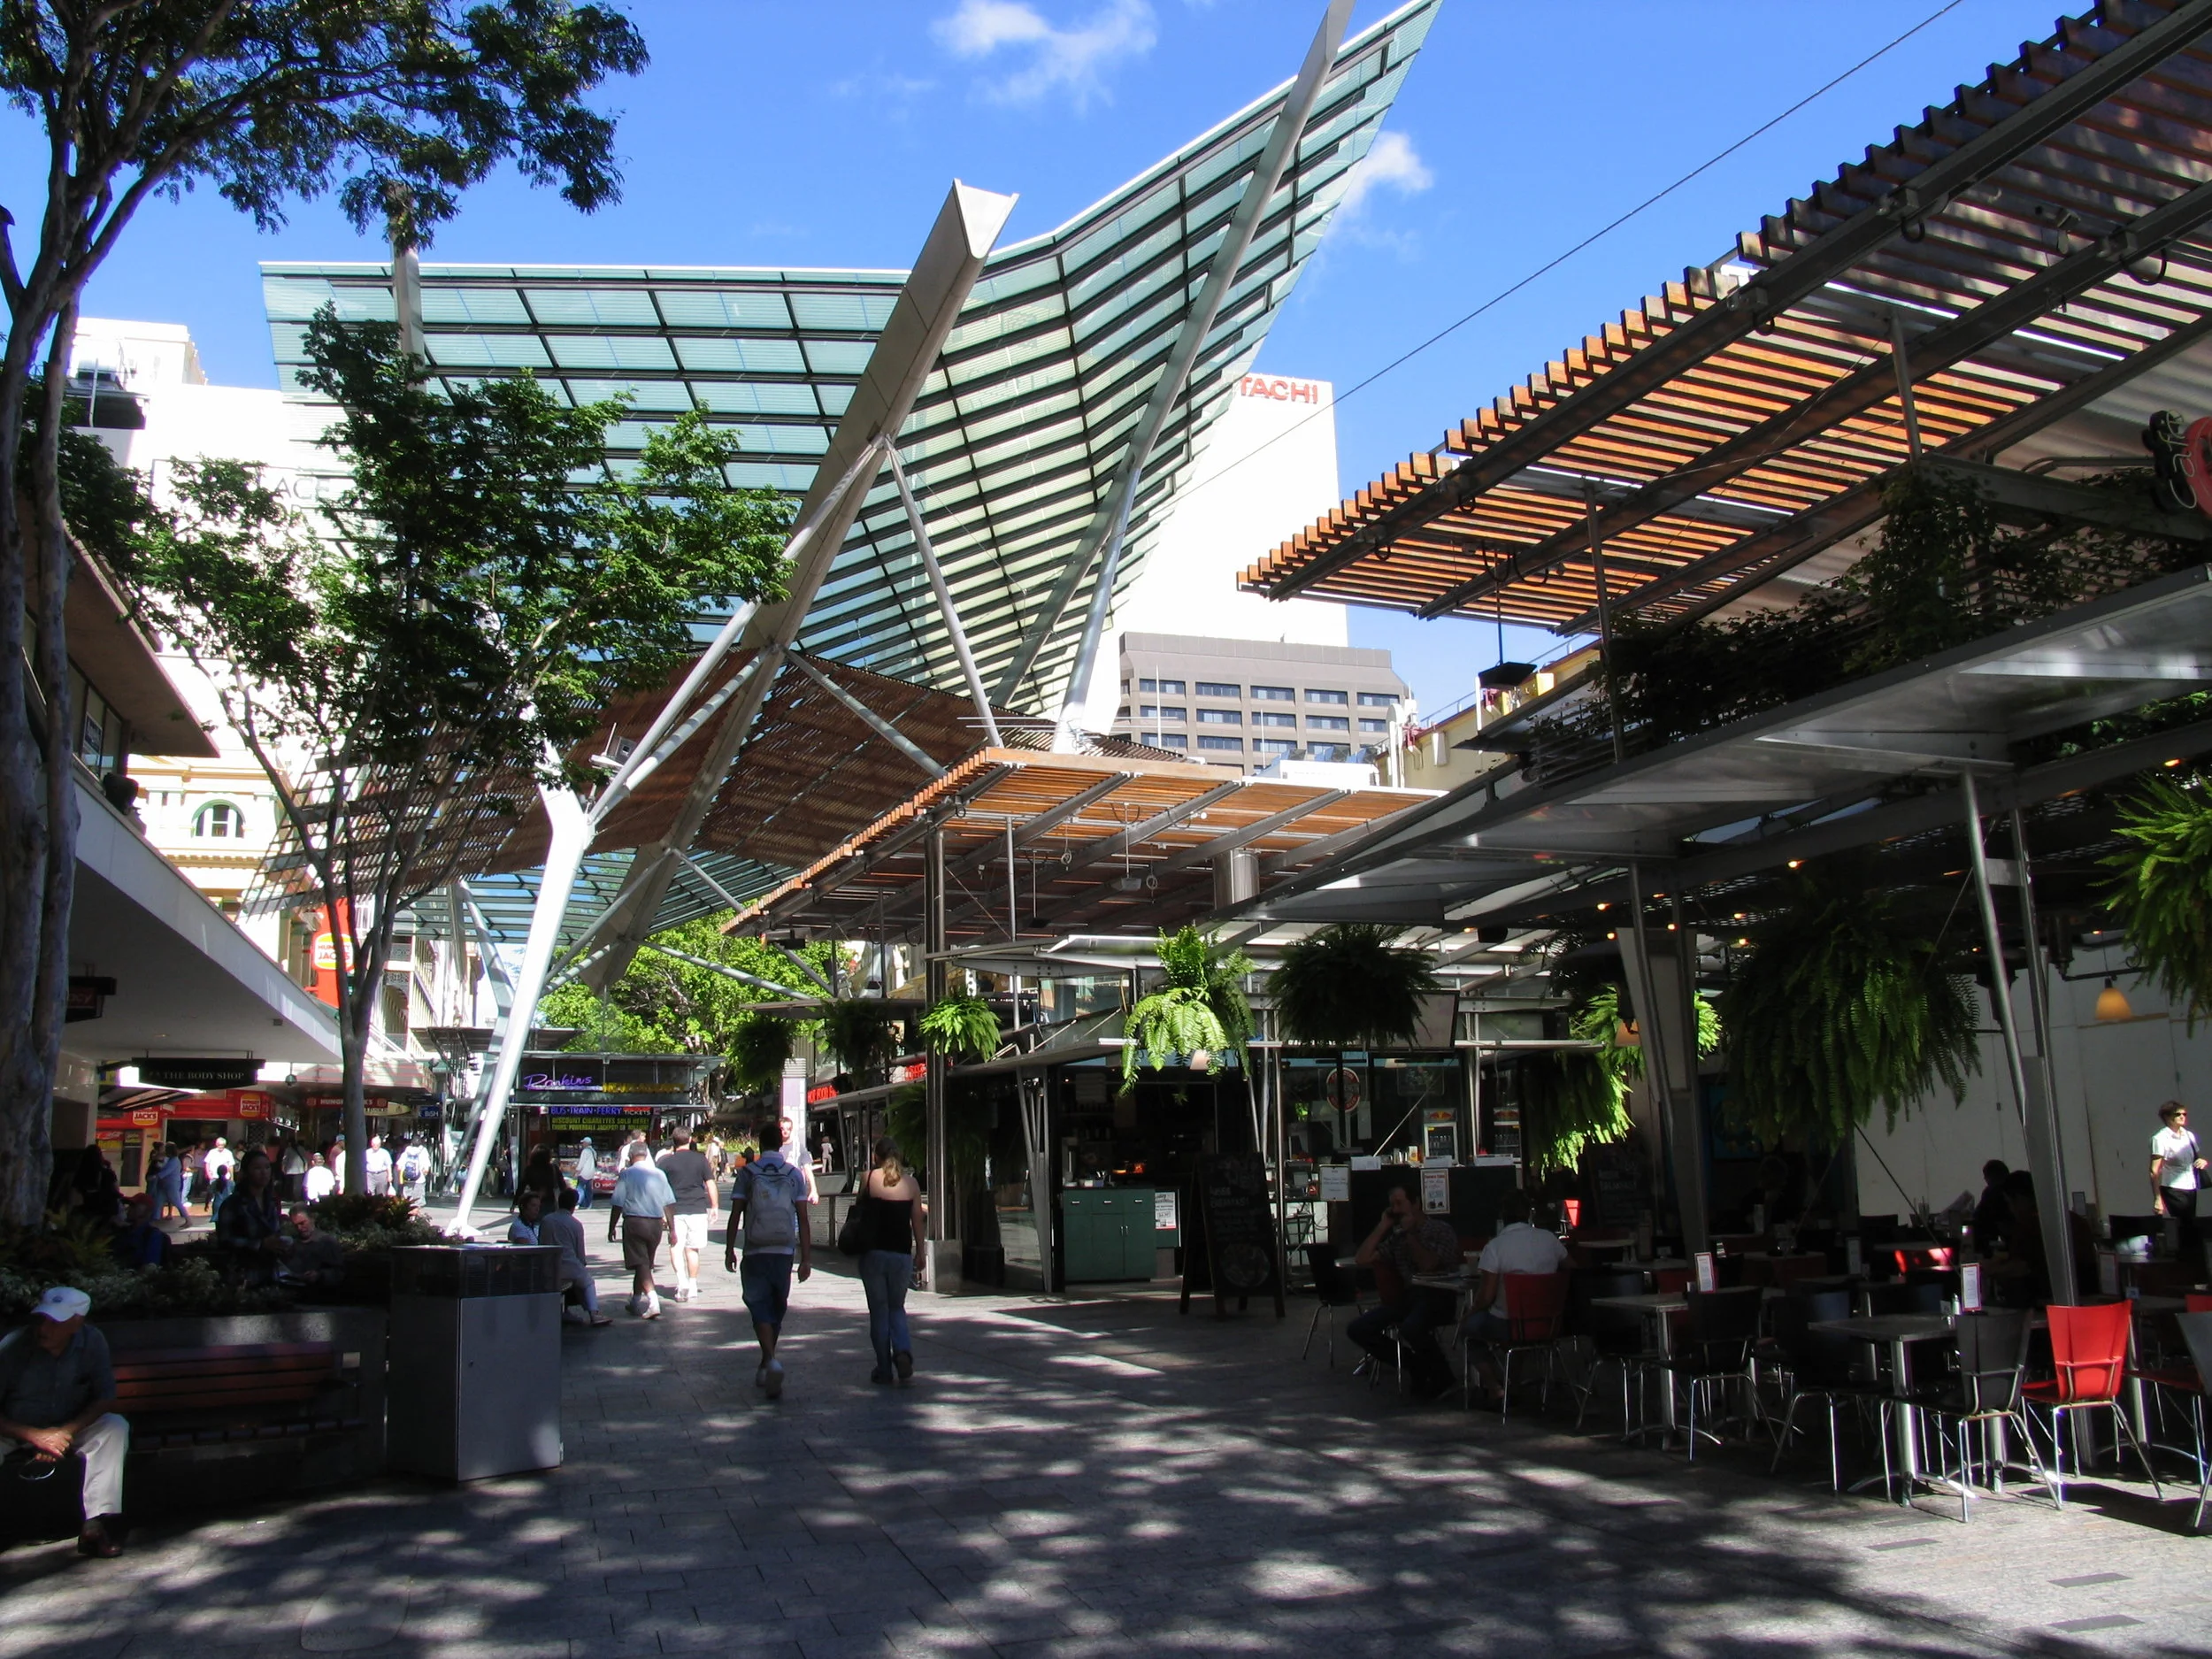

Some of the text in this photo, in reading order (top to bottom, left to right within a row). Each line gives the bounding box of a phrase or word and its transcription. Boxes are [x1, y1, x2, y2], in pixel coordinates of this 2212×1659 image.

[1240, 376, 1318, 404] TACHI
[163, 1071, 244, 1080] THE BODY SHOP
